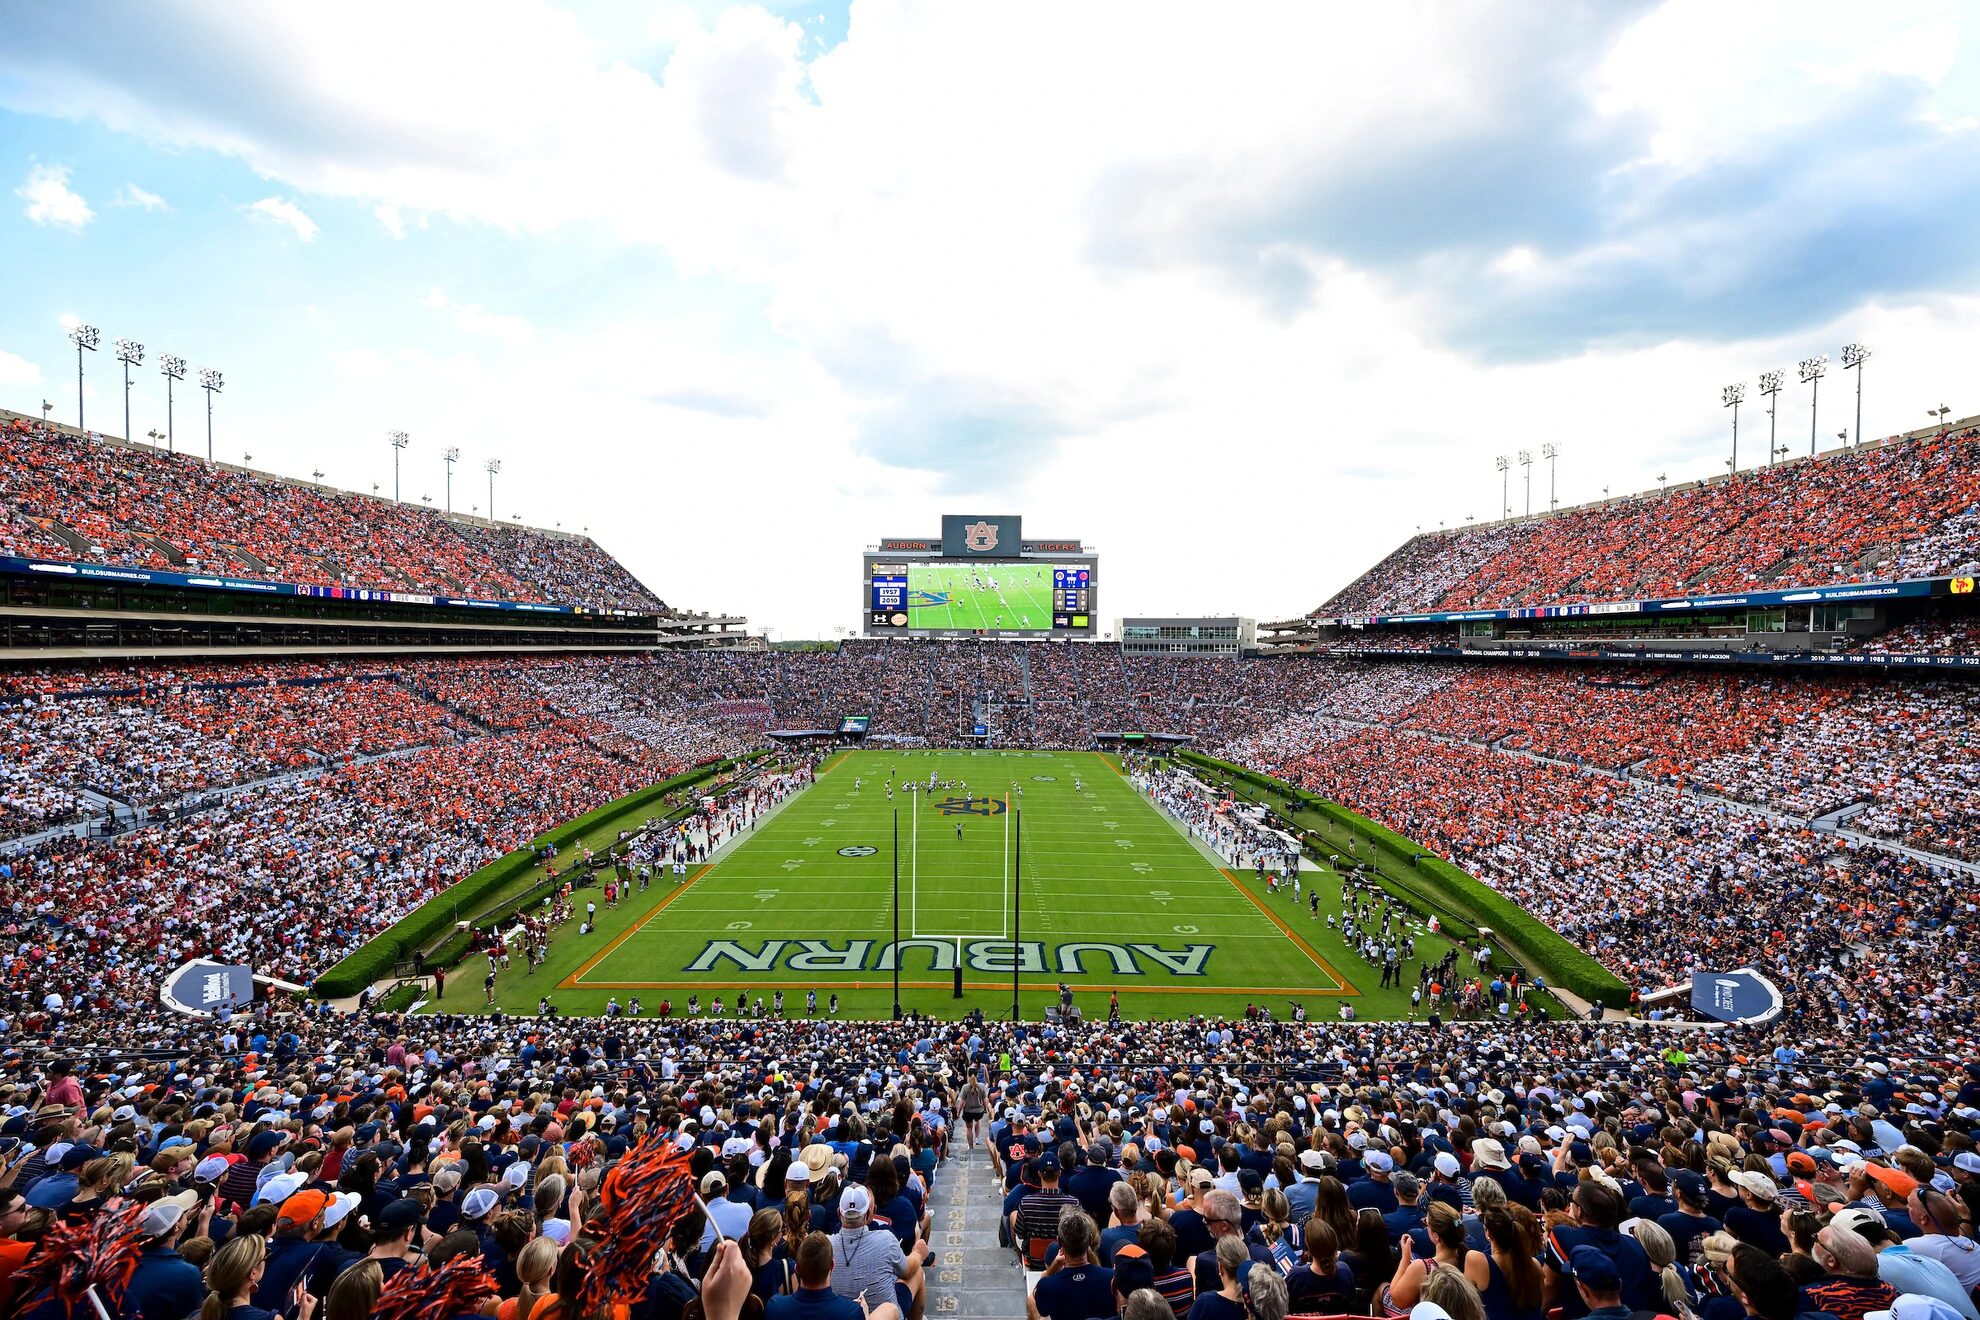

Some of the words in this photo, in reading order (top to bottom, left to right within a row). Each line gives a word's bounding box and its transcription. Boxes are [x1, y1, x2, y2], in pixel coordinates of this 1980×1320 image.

[886, 542, 926, 550] AUBURN
[1038, 543, 1076, 551] TIGERS
[81, 568, 151, 580] BUILDSUBMARINES.COM
[1825, 587, 1899, 599] BUILDSUBMARINES.COM
[1913, 656, 1930, 664] 1983
[1936, 657, 1954, 665] 1957
[1961, 657, 1980, 665] 1932
[681, 939, 1217, 976] AUBURN
